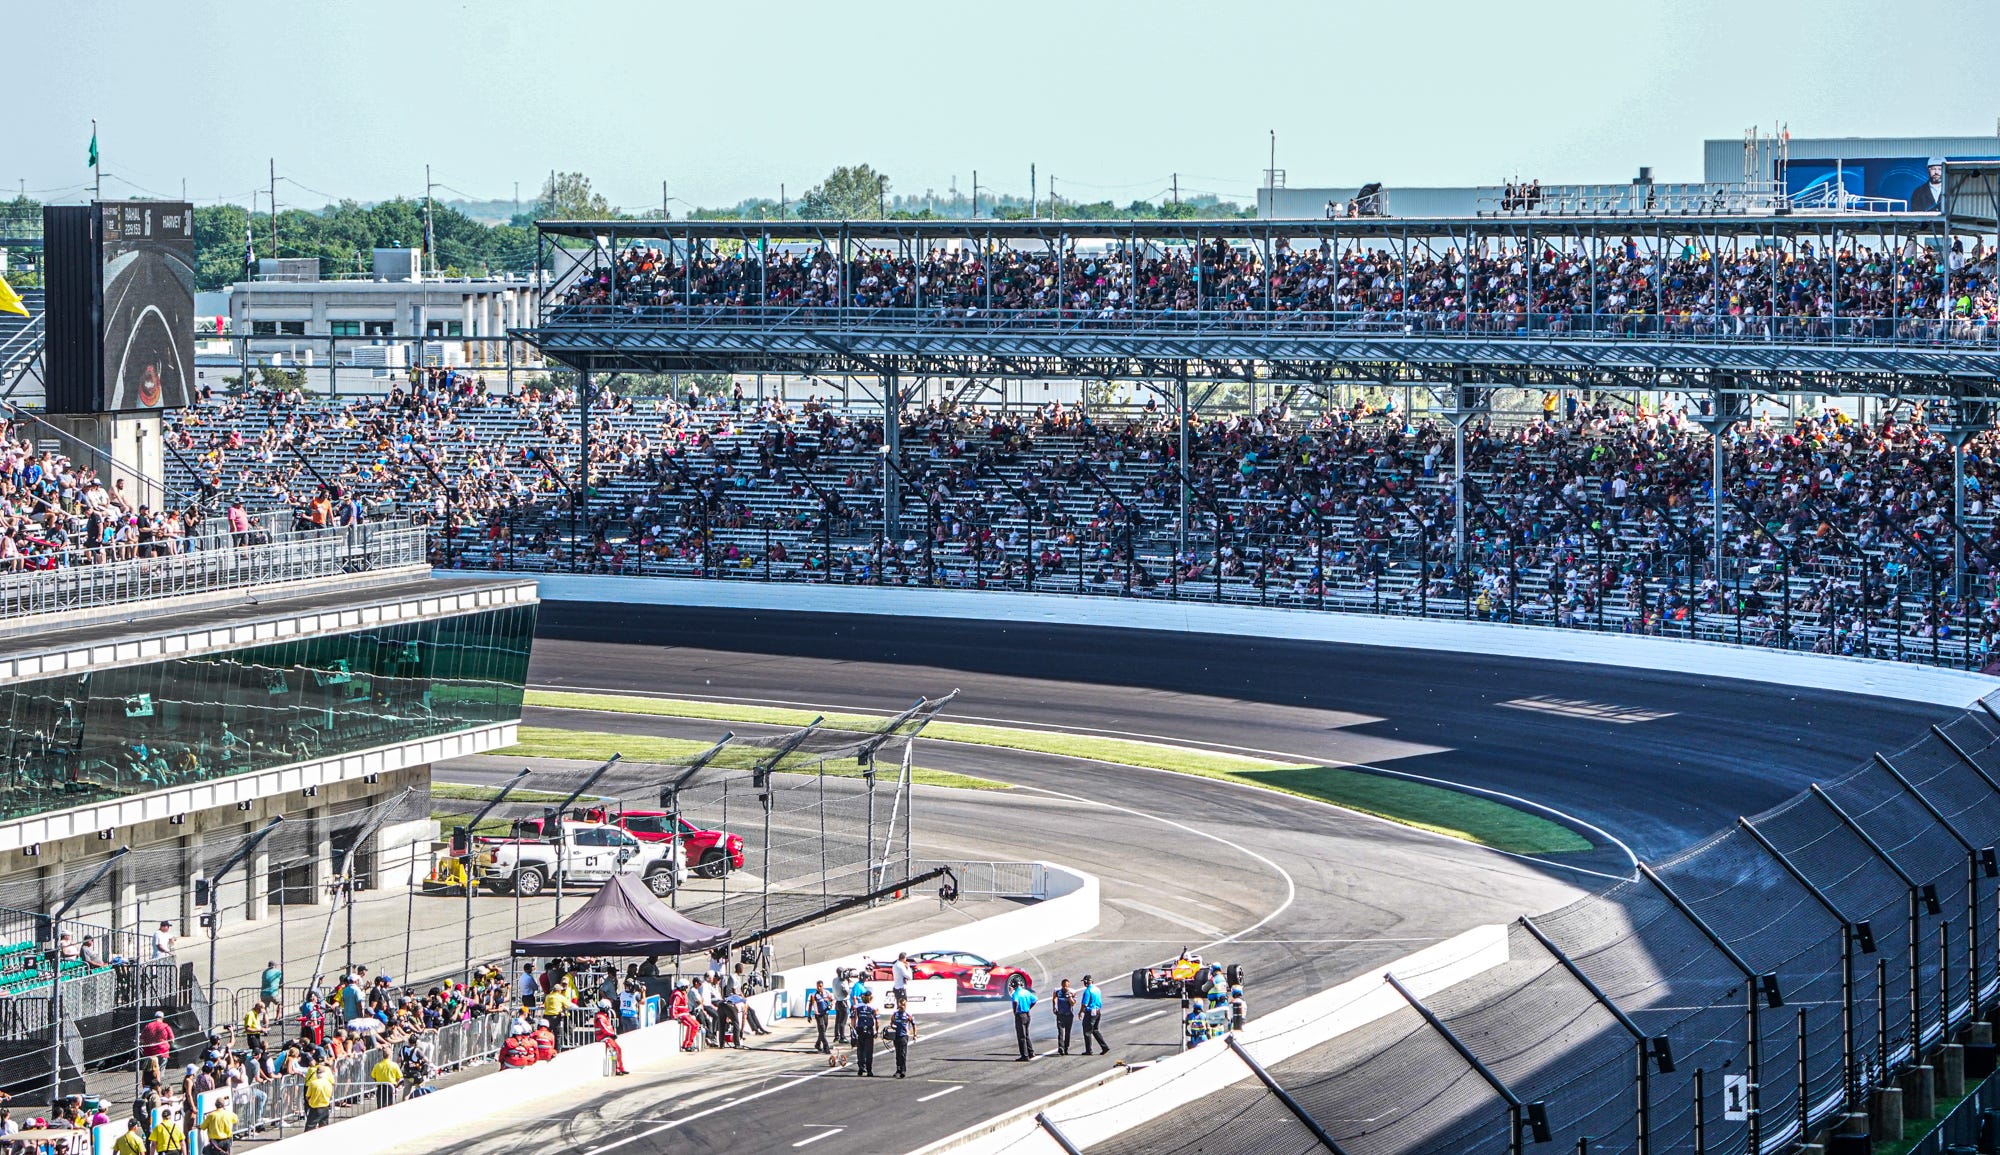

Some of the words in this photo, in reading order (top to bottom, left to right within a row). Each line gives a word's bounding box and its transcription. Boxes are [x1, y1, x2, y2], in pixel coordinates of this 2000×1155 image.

[162, 215, 181, 228] HARVEY
[240, 801, 247, 810] 3
[171, 815, 178, 824] 4
[101, 830, 108, 839] 5
[25, 845, 32, 855] 6
[585, 856, 598, 866] C1
[970, 973, 991, 984] 500
[1728, 1084, 1743, 1112] 1
